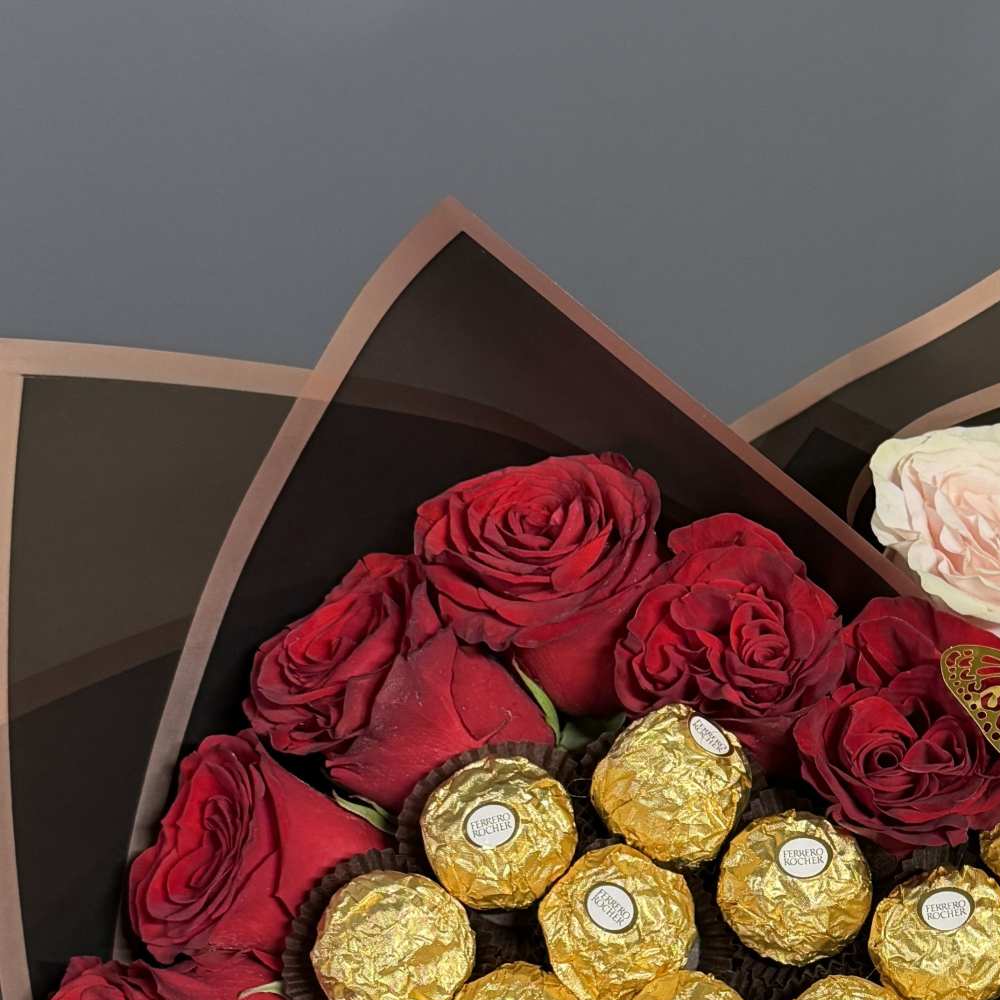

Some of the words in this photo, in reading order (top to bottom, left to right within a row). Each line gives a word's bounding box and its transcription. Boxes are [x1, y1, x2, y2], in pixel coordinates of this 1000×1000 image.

[471, 813, 510, 829] FERRERO
[472, 822, 512, 837] ROCHER
[783, 848, 823, 857] FERRERO
[784, 857, 824, 865] ROCHER
[591, 895, 625, 926] ROCHER
[598, 889, 630, 920] FERRERO
[926, 900, 966, 912] FERRERO
[927, 909, 967, 920] ROCHER
